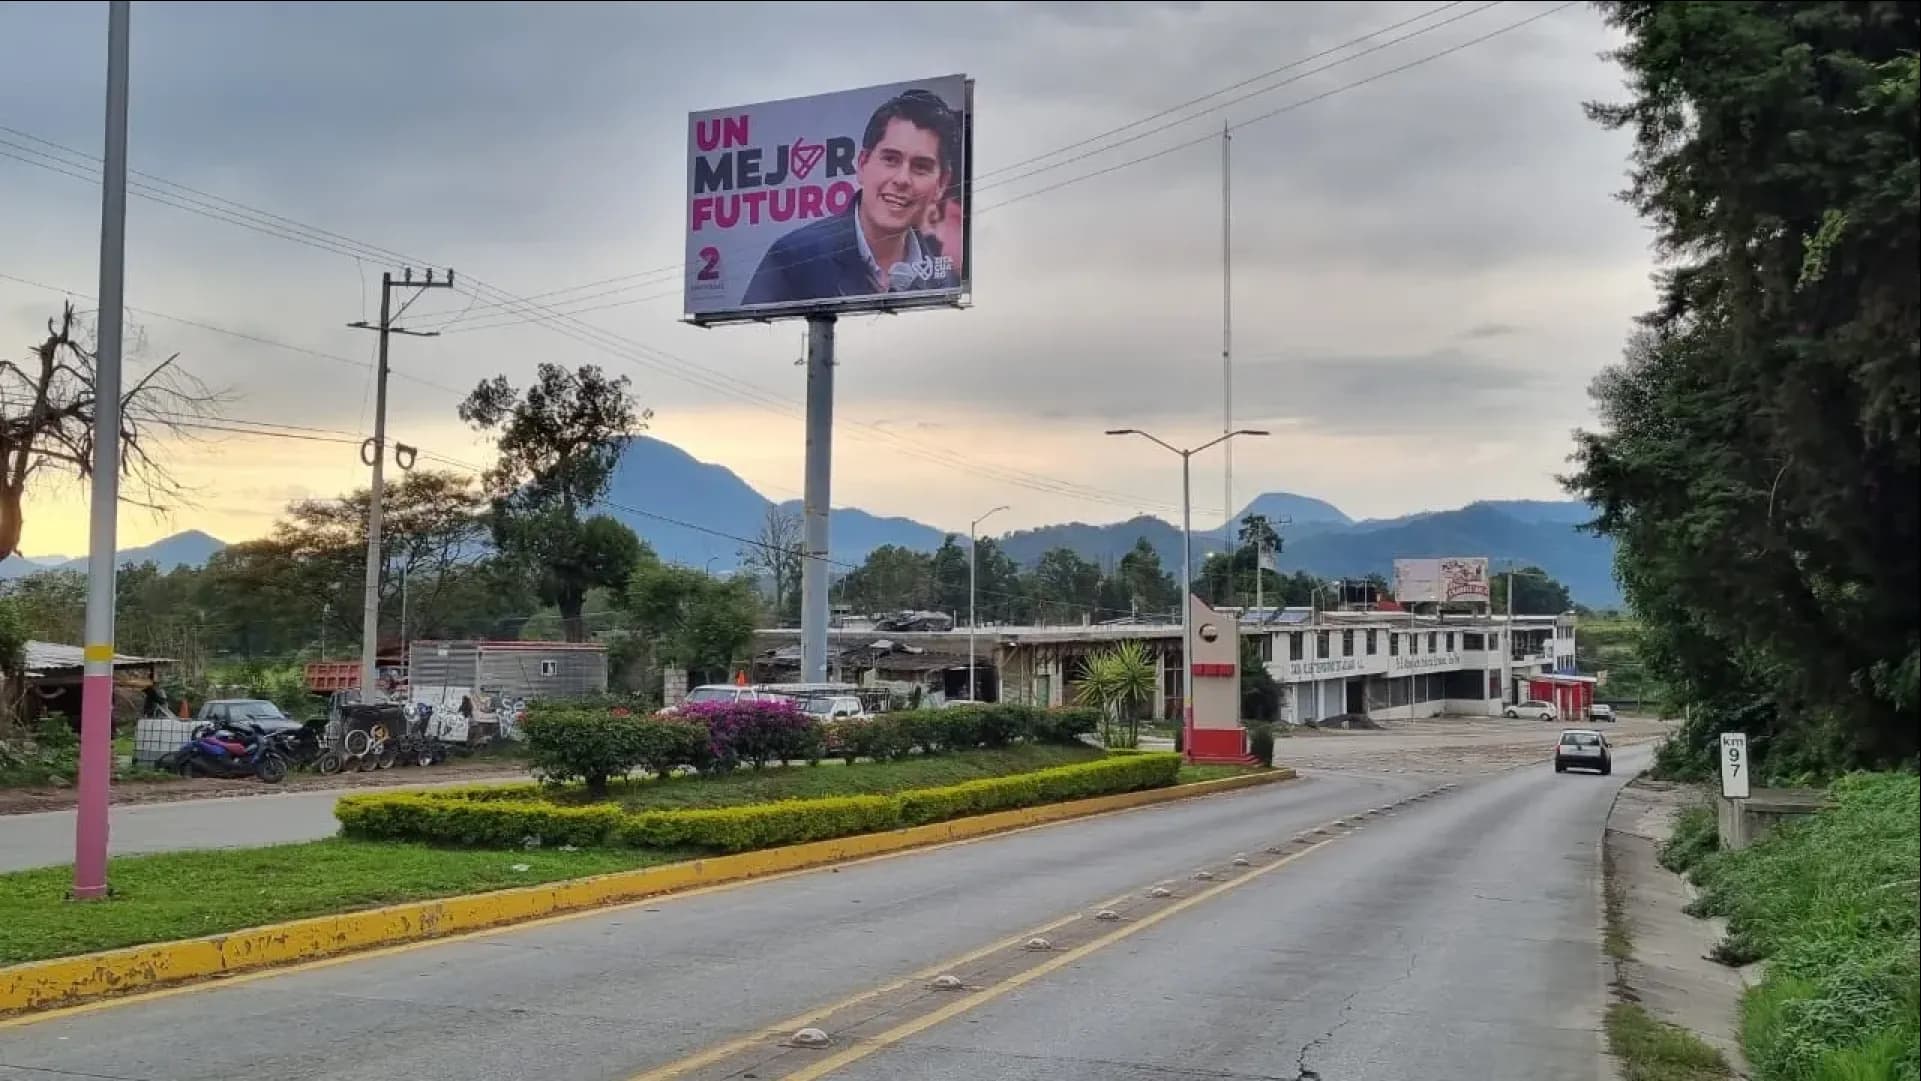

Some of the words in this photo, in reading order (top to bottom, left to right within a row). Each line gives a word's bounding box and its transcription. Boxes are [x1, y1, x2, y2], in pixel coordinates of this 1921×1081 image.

[696, 115, 749, 151] UN
[692, 181, 855, 232] FUTURO
[697, 246, 720, 281] 2
[1723, 736, 1744, 747] km
